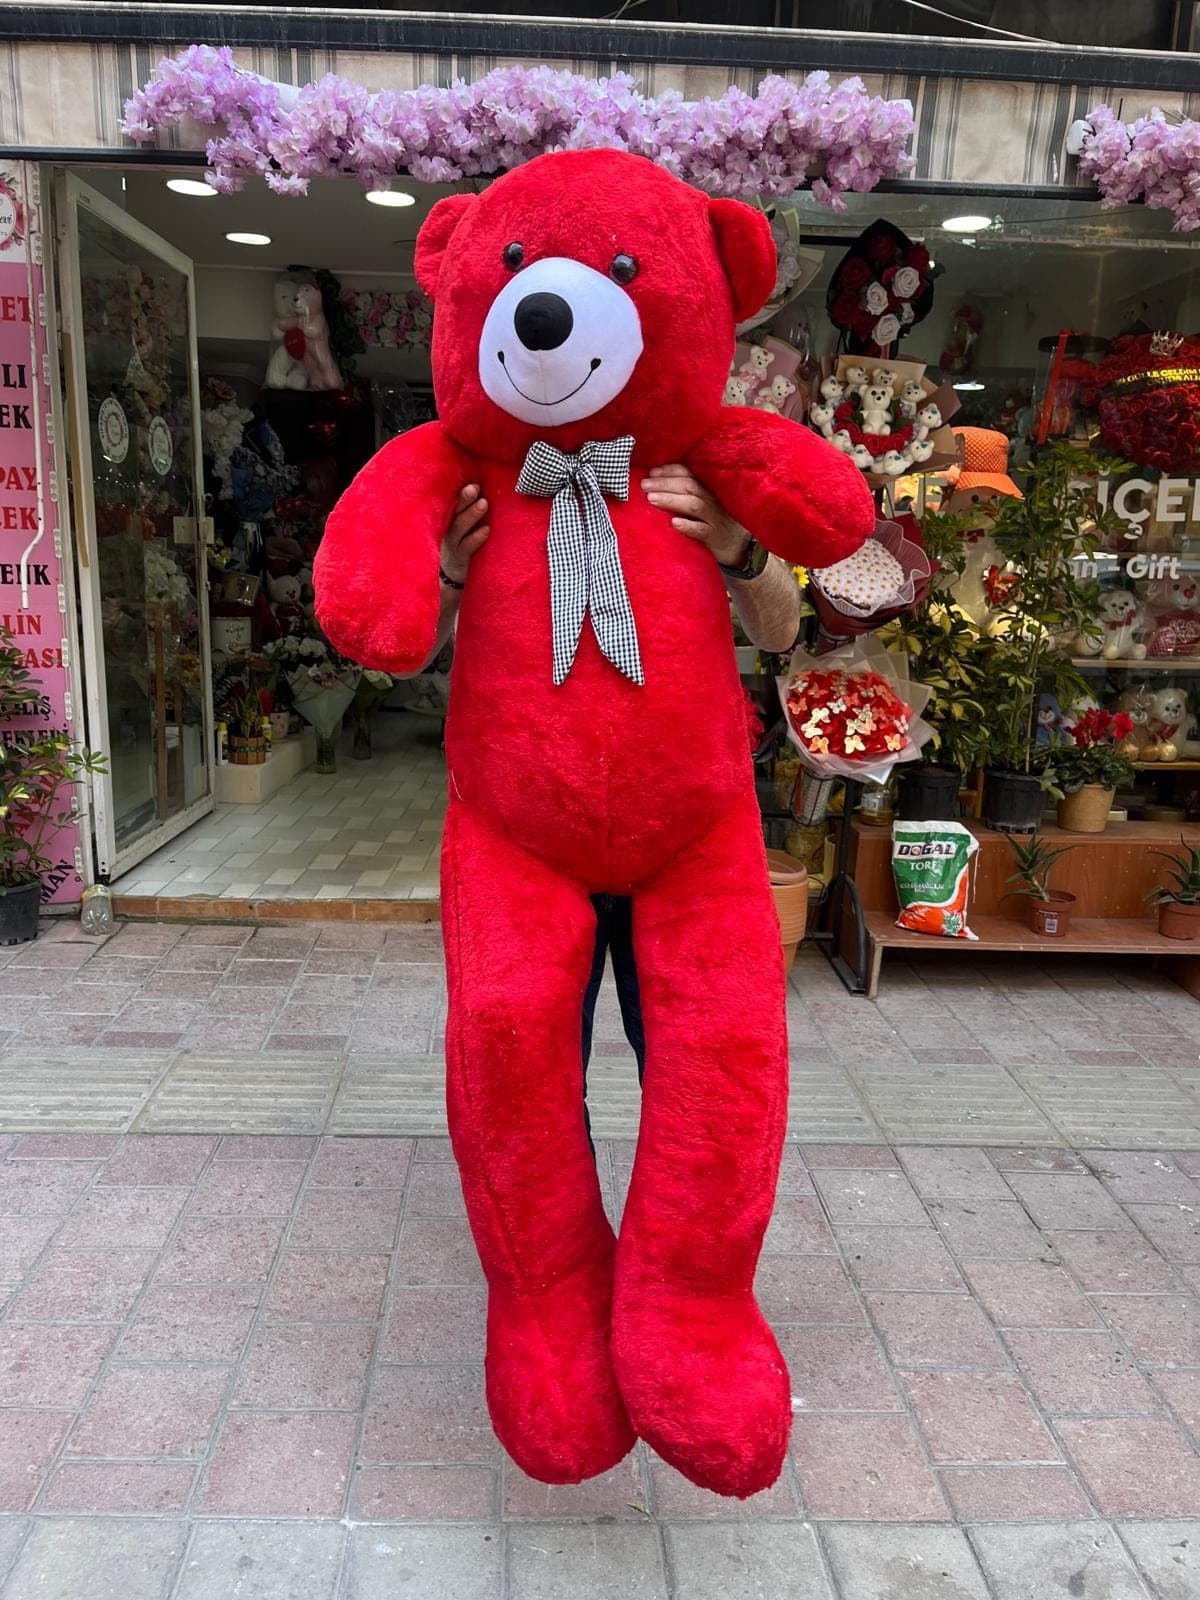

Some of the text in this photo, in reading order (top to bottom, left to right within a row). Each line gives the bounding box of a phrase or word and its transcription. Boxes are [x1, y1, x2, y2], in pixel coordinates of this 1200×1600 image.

[0, 506, 39, 530] EK
[1126, 553, 1182, 580] Gift
[897, 840, 954, 856] DOĞAL
